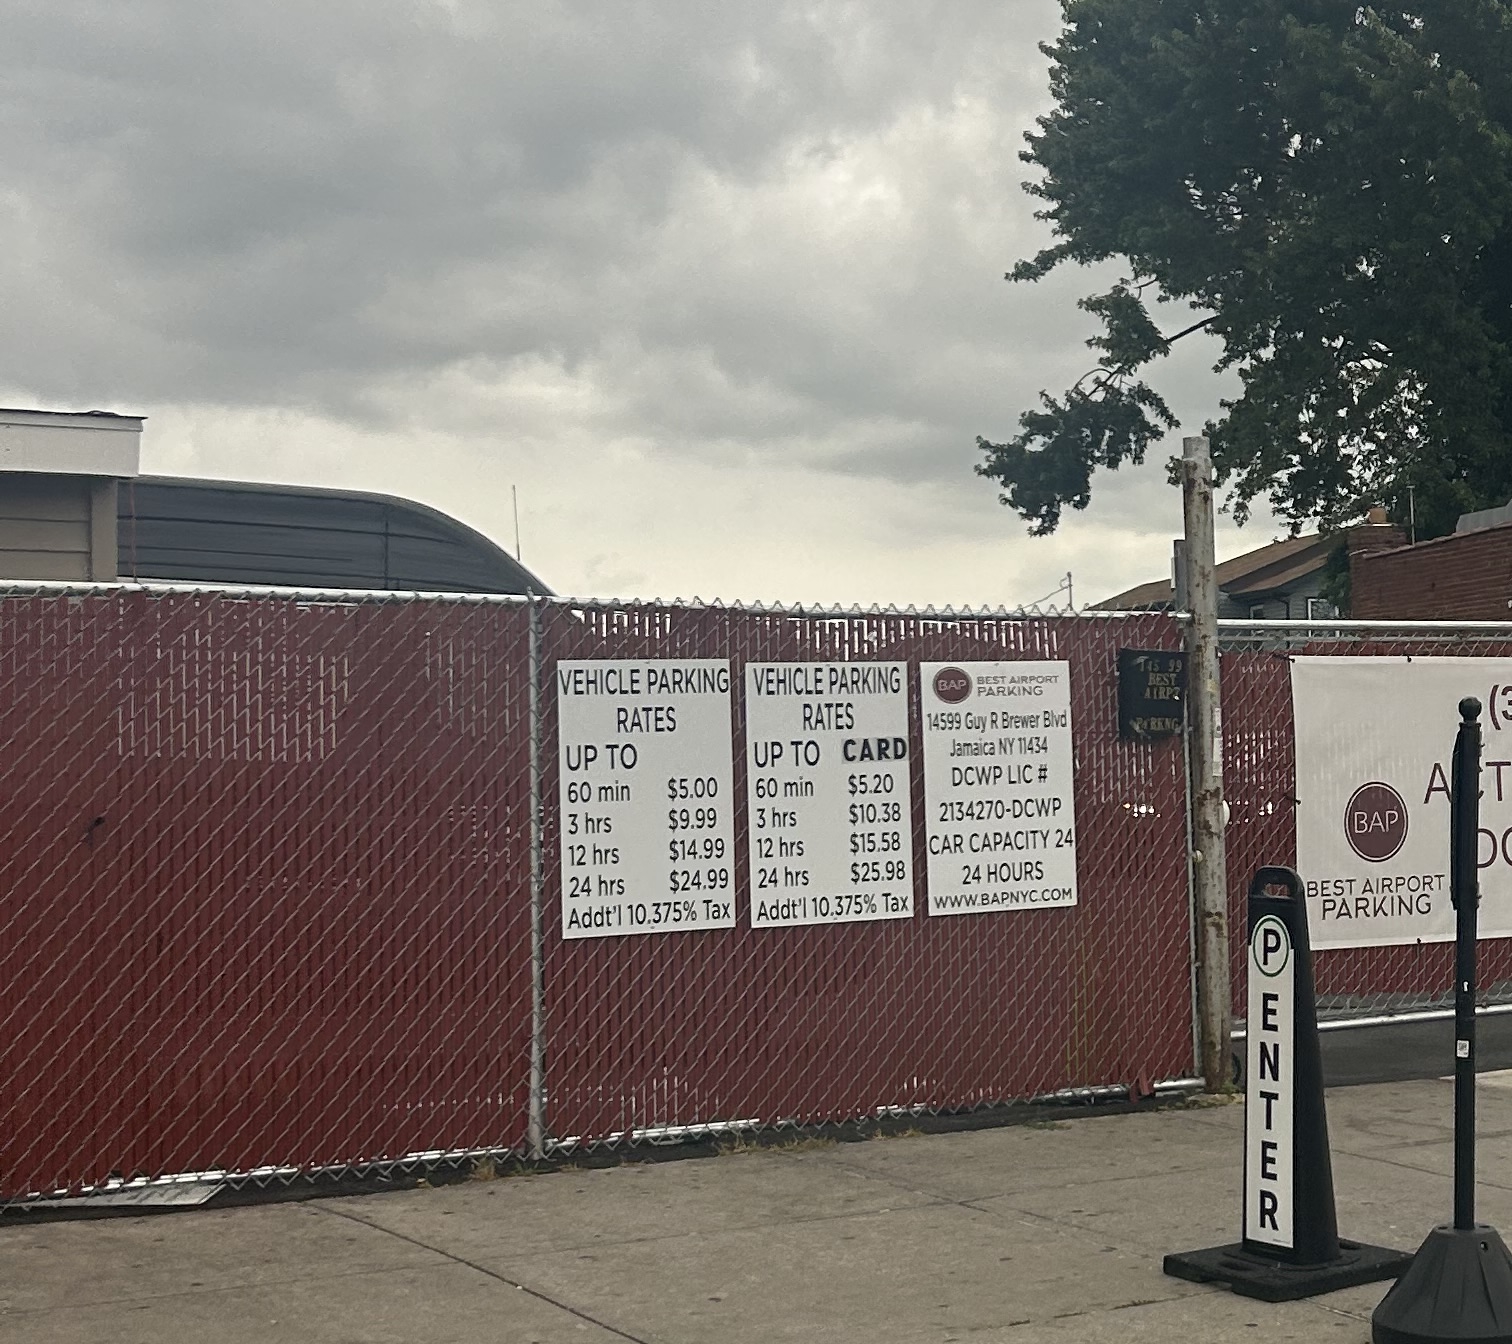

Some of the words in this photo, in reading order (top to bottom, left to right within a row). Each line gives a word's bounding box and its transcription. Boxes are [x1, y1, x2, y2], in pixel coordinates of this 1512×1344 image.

[559, 668, 641, 695] VEHICLE
[647, 667, 729, 694] PARKING
[753, 667, 823, 696] VEHICLE
[829, 666, 901, 694] PARKING
[937, 679, 967, 691] BAP
[977, 676, 1007, 685] BEST
[1009, 675, 1059, 685] AIRPORT
[977, 685, 1044, 697] PARKING
[1148, 672, 1177, 686] BEST
[617, 706, 677, 733] RATES
[802, 702, 855, 731] RATES
[927, 712, 961, 731] 14599
[965, 712, 988, 733] Guy
[990, 711, 999, 729] R
[1002, 711, 1040, 729] Brewer
[1043, 709, 1067, 728] Blvd
[566, 744, 598, 771] UP
[605, 743, 638, 770] TO
[754, 741, 783, 768] UP
[790, 739, 820, 766] TO
[843, 737, 907, 762] CARD
[950, 737, 996, 757] Jamaica
[999, 737, 1016, 755] NY
[1017, 736, 1048, 754] 11434
[756, 777, 778, 799] 60
[784, 776, 814, 798] min
[848, 773, 894, 797] $5.20
[952, 765, 1003, 787] DCWP
[1008, 764, 1033, 784] LIC
[1037, 763, 1048, 783] #
[568, 781, 592, 803] 60
[598, 780, 631, 802] min
[667, 777, 718, 802] $5.00
[568, 813, 578, 835] 3
[585, 812, 612, 834] hrs
[668, 807, 717, 833] $9.99
[756, 808, 766, 828] 3
[772, 807, 797, 828] hrs
[849, 802, 901, 826] $10.38
[939, 797, 1062, 822] 2134270-DCWP
[1354, 809, 1399, 834] BAP
[568, 844, 586, 866] 12
[593, 843, 620, 865] hrs
[669, 838, 725, 863] $14.99
[757, 837, 774, 858] 12
[779, 836, 805, 857] hrs
[850, 831, 901, 856] $15.58
[929, 834, 964, 855] CAR
[969, 829, 1050, 853] CAPACITY
[1055, 827, 1074, 848] 24
[569, 876, 592, 898] 24
[598, 874, 625, 896] hrs
[669, 868, 729, 894] $24.99
[758, 867, 778, 888] 24
[785, 866, 810, 887] hrs
[851, 860, 906, 885] $25.98
[962, 864, 982, 885] 24
[987, 860, 1044, 883] HOURS
[934, 888, 1073, 909] WWW.BAPNYC.COM
[1307, 878, 1357, 898] BEST
[1361, 874, 1446, 895] AIRPORT
[627, 900, 698, 925] 10.375%
[703, 899, 731, 920] Tax
[812, 893, 877, 917] 10.375%
[882, 892, 909, 912] Tax
[1321, 893, 1432, 920] PARKING
[1263, 928, 1281, 966] P
[1259, 993, 1280, 1231] ENTER
